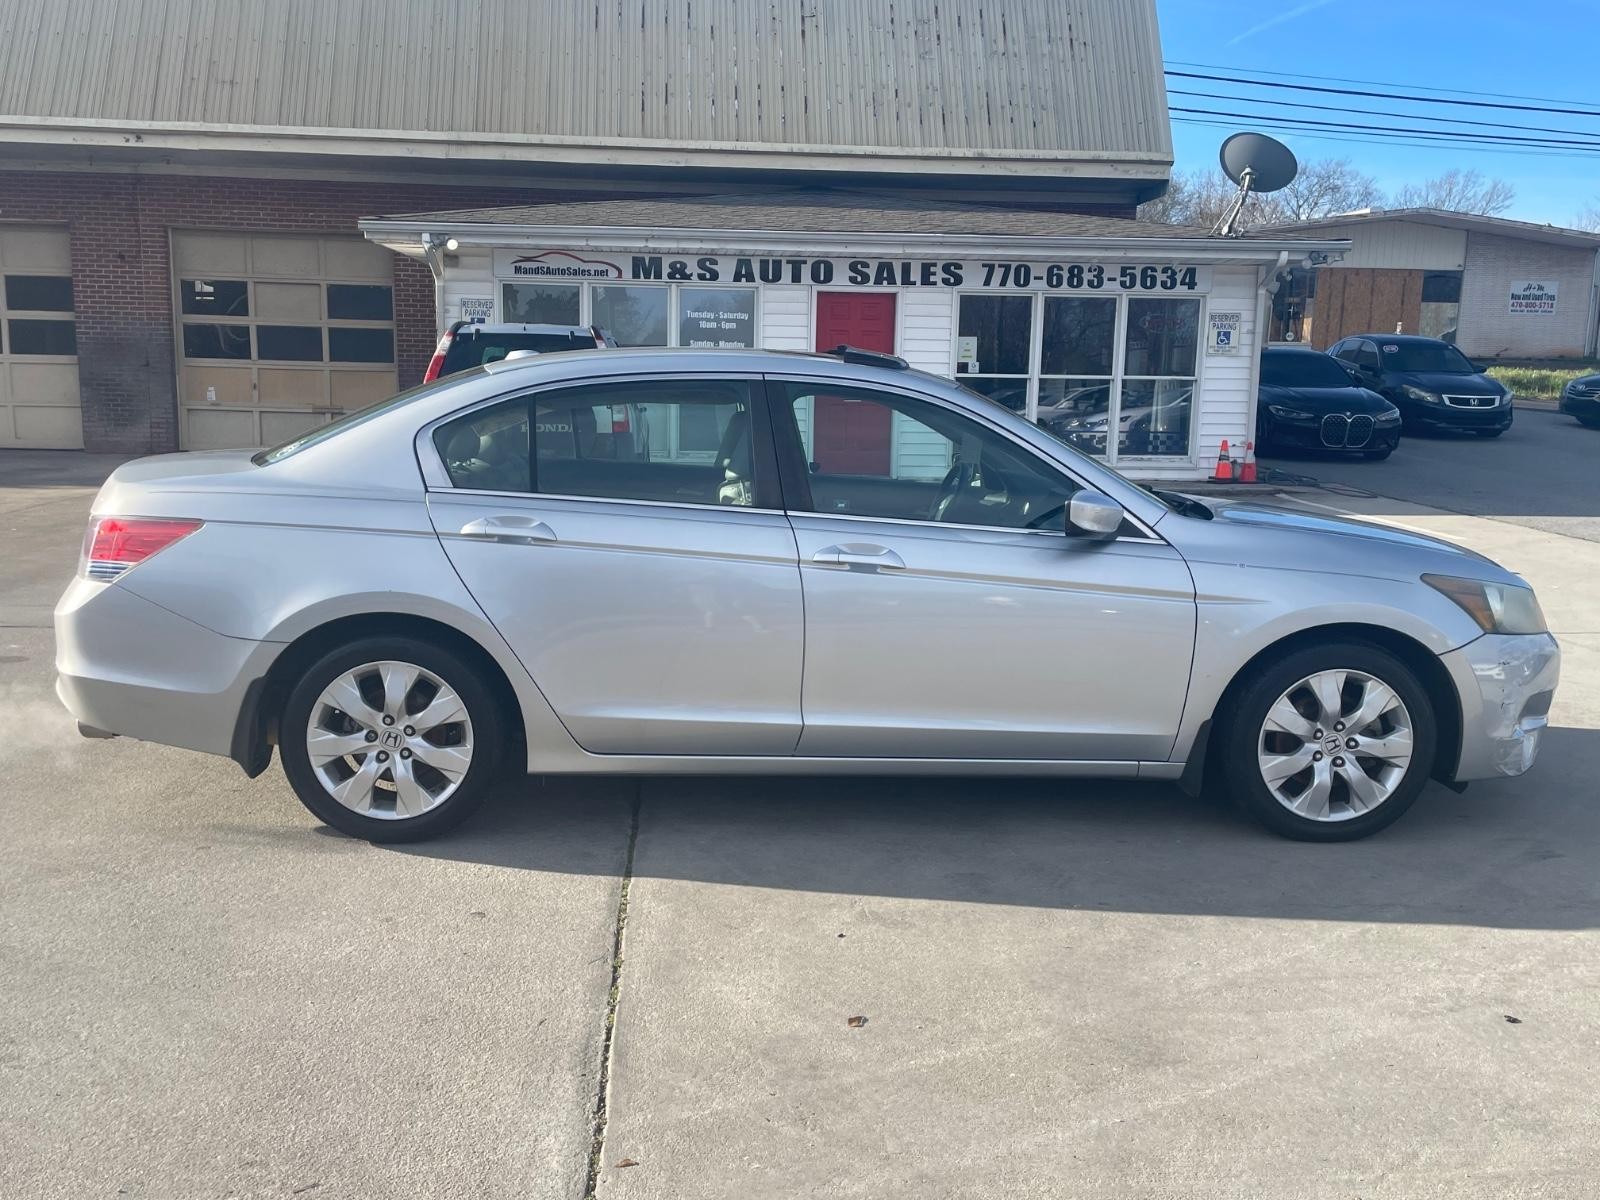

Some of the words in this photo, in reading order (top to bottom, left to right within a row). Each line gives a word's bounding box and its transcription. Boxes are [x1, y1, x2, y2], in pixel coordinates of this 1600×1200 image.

[514, 265, 609, 277] MandSAutoSales.net
[631, 256, 720, 282] M&S
[732, 258, 834, 284] AUTO
[848, 260, 963, 287] SALES
[981, 263, 1198, 290] 770-683-5634
[462, 300, 494, 309] RESERVED
[464, 309, 491, 317] PARKING
[686, 310, 714, 319] Tuesday
[720, 312, 748, 320] Saturday
